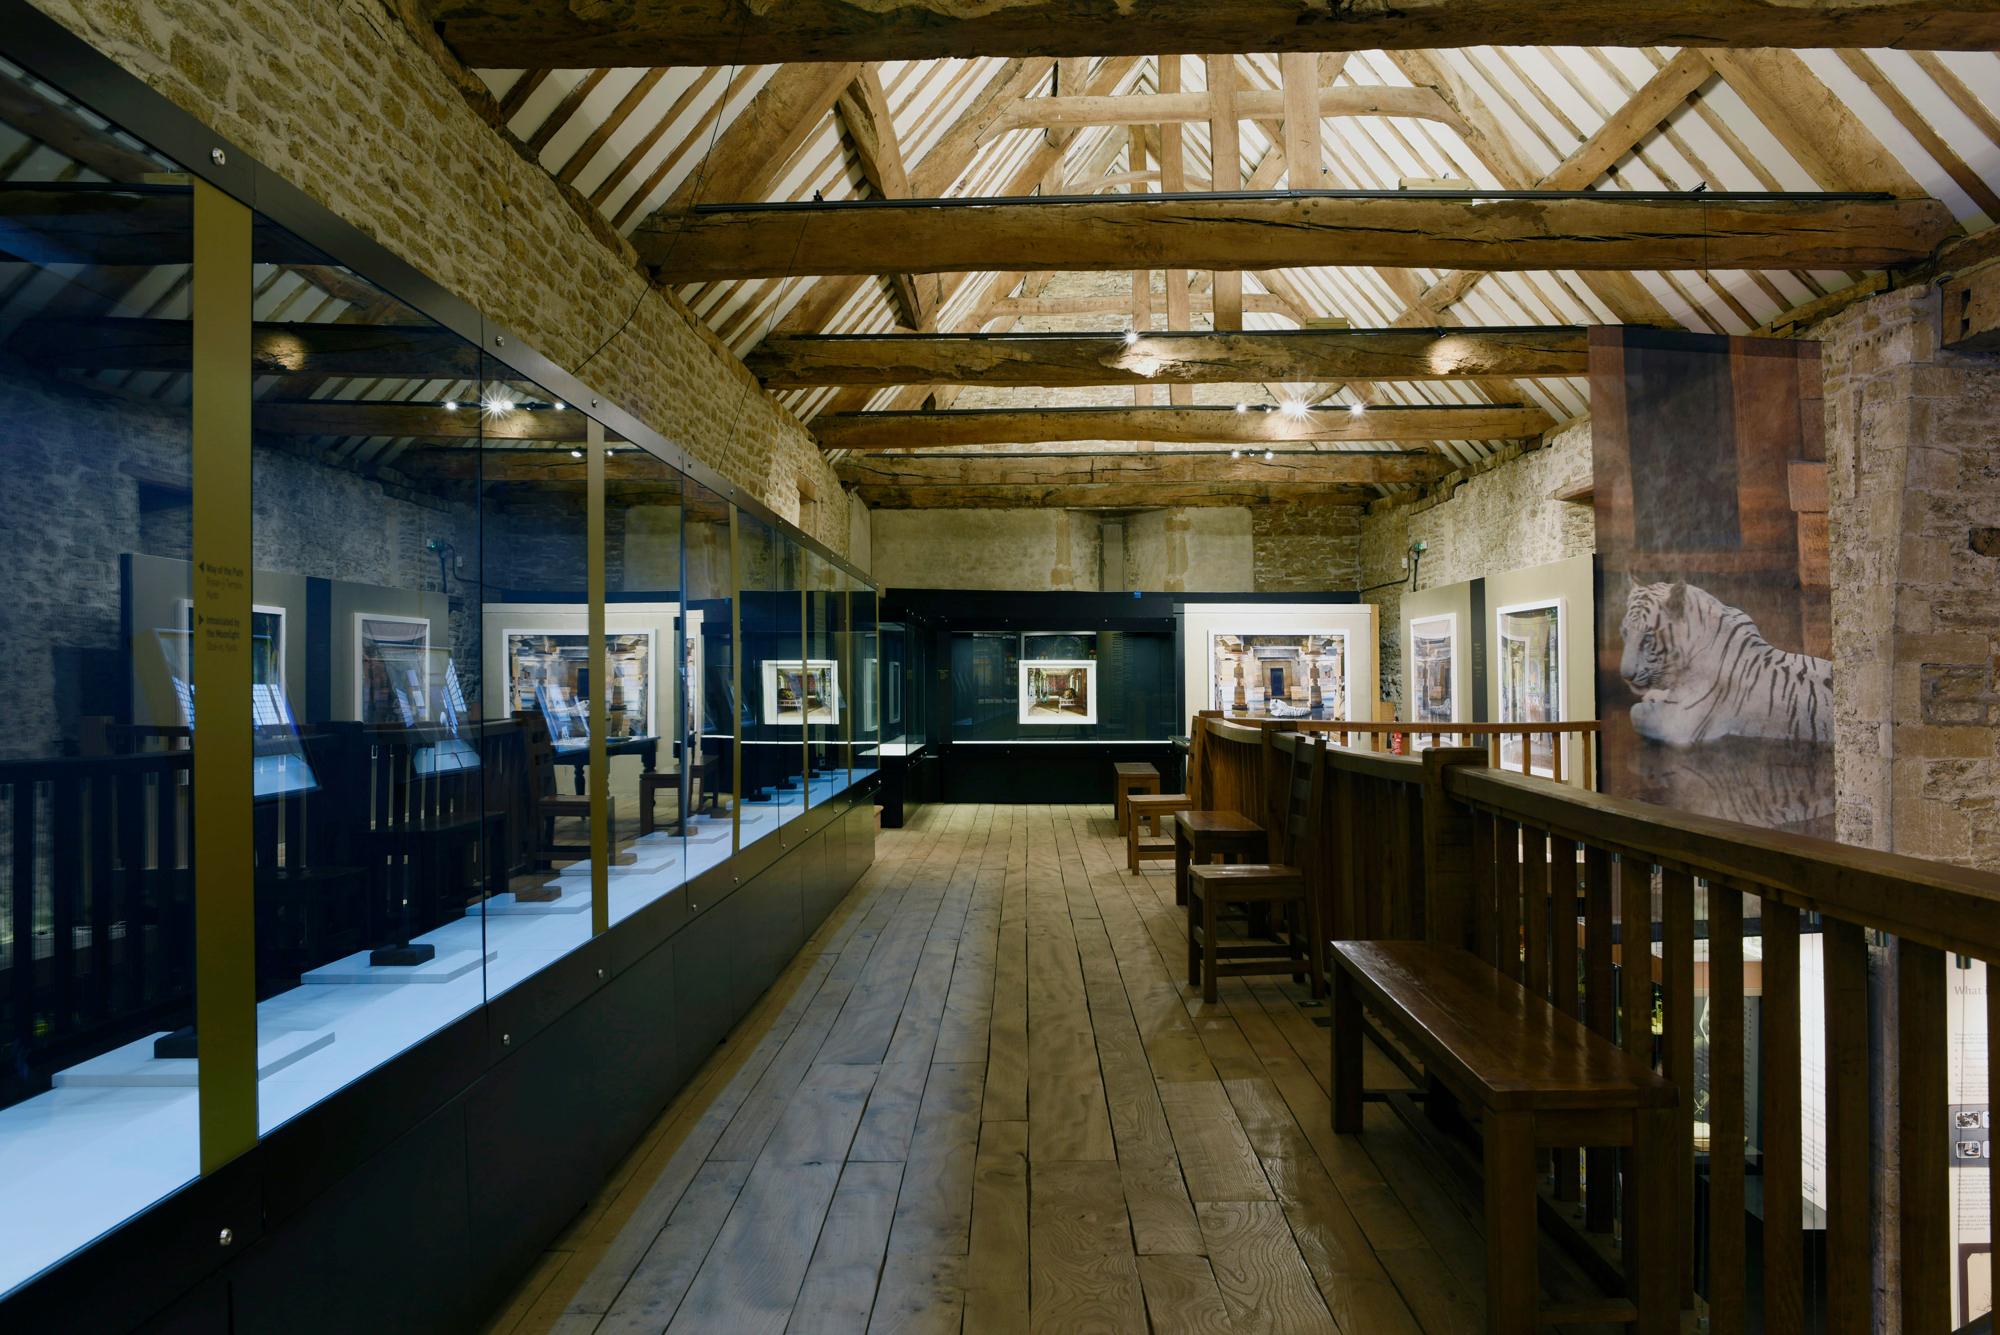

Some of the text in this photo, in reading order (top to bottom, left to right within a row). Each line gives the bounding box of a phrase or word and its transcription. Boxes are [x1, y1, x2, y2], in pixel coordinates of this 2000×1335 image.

[206, 563, 244, 577] Way of the Path
[206, 615, 240, 629] Intoxicated by
[206, 628, 240, 641] the Moonlight
[1954, 985, 1982, 995] What
